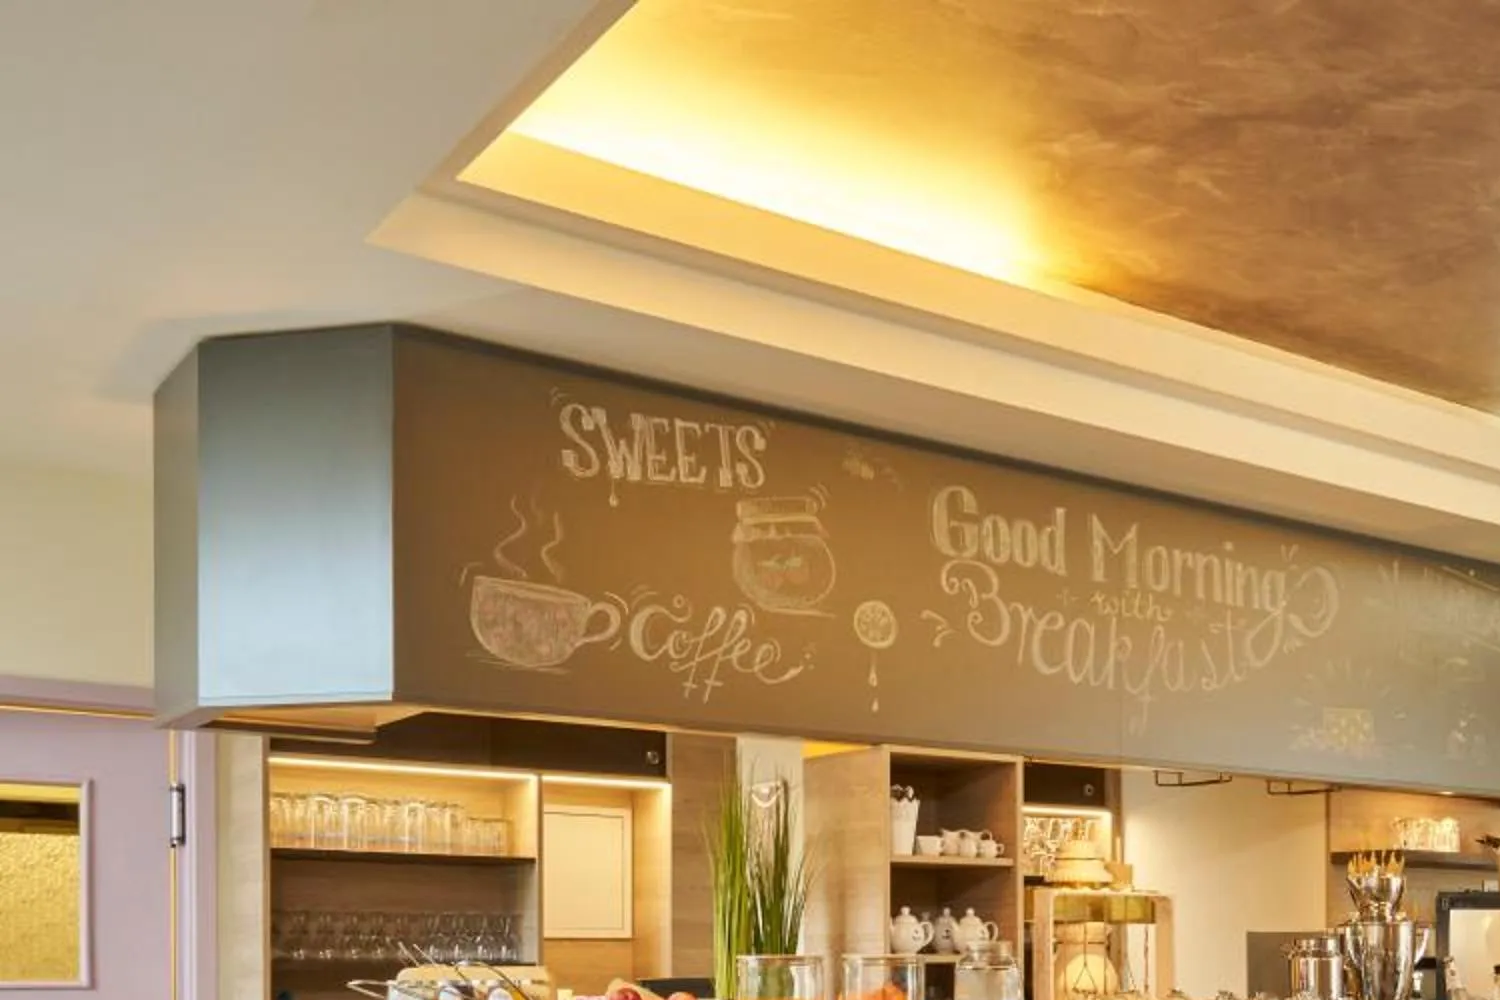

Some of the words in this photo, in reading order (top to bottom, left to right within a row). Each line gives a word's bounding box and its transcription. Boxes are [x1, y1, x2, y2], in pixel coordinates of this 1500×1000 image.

[559, 402, 767, 488] SWEETS
[930, 485, 1067, 577] Good
[1091, 513, 1291, 668] Morning
[1089, 590, 1174, 622] with
[628, 597, 806, 703] Coffee
[941, 560, 1250, 736] Breakfast
